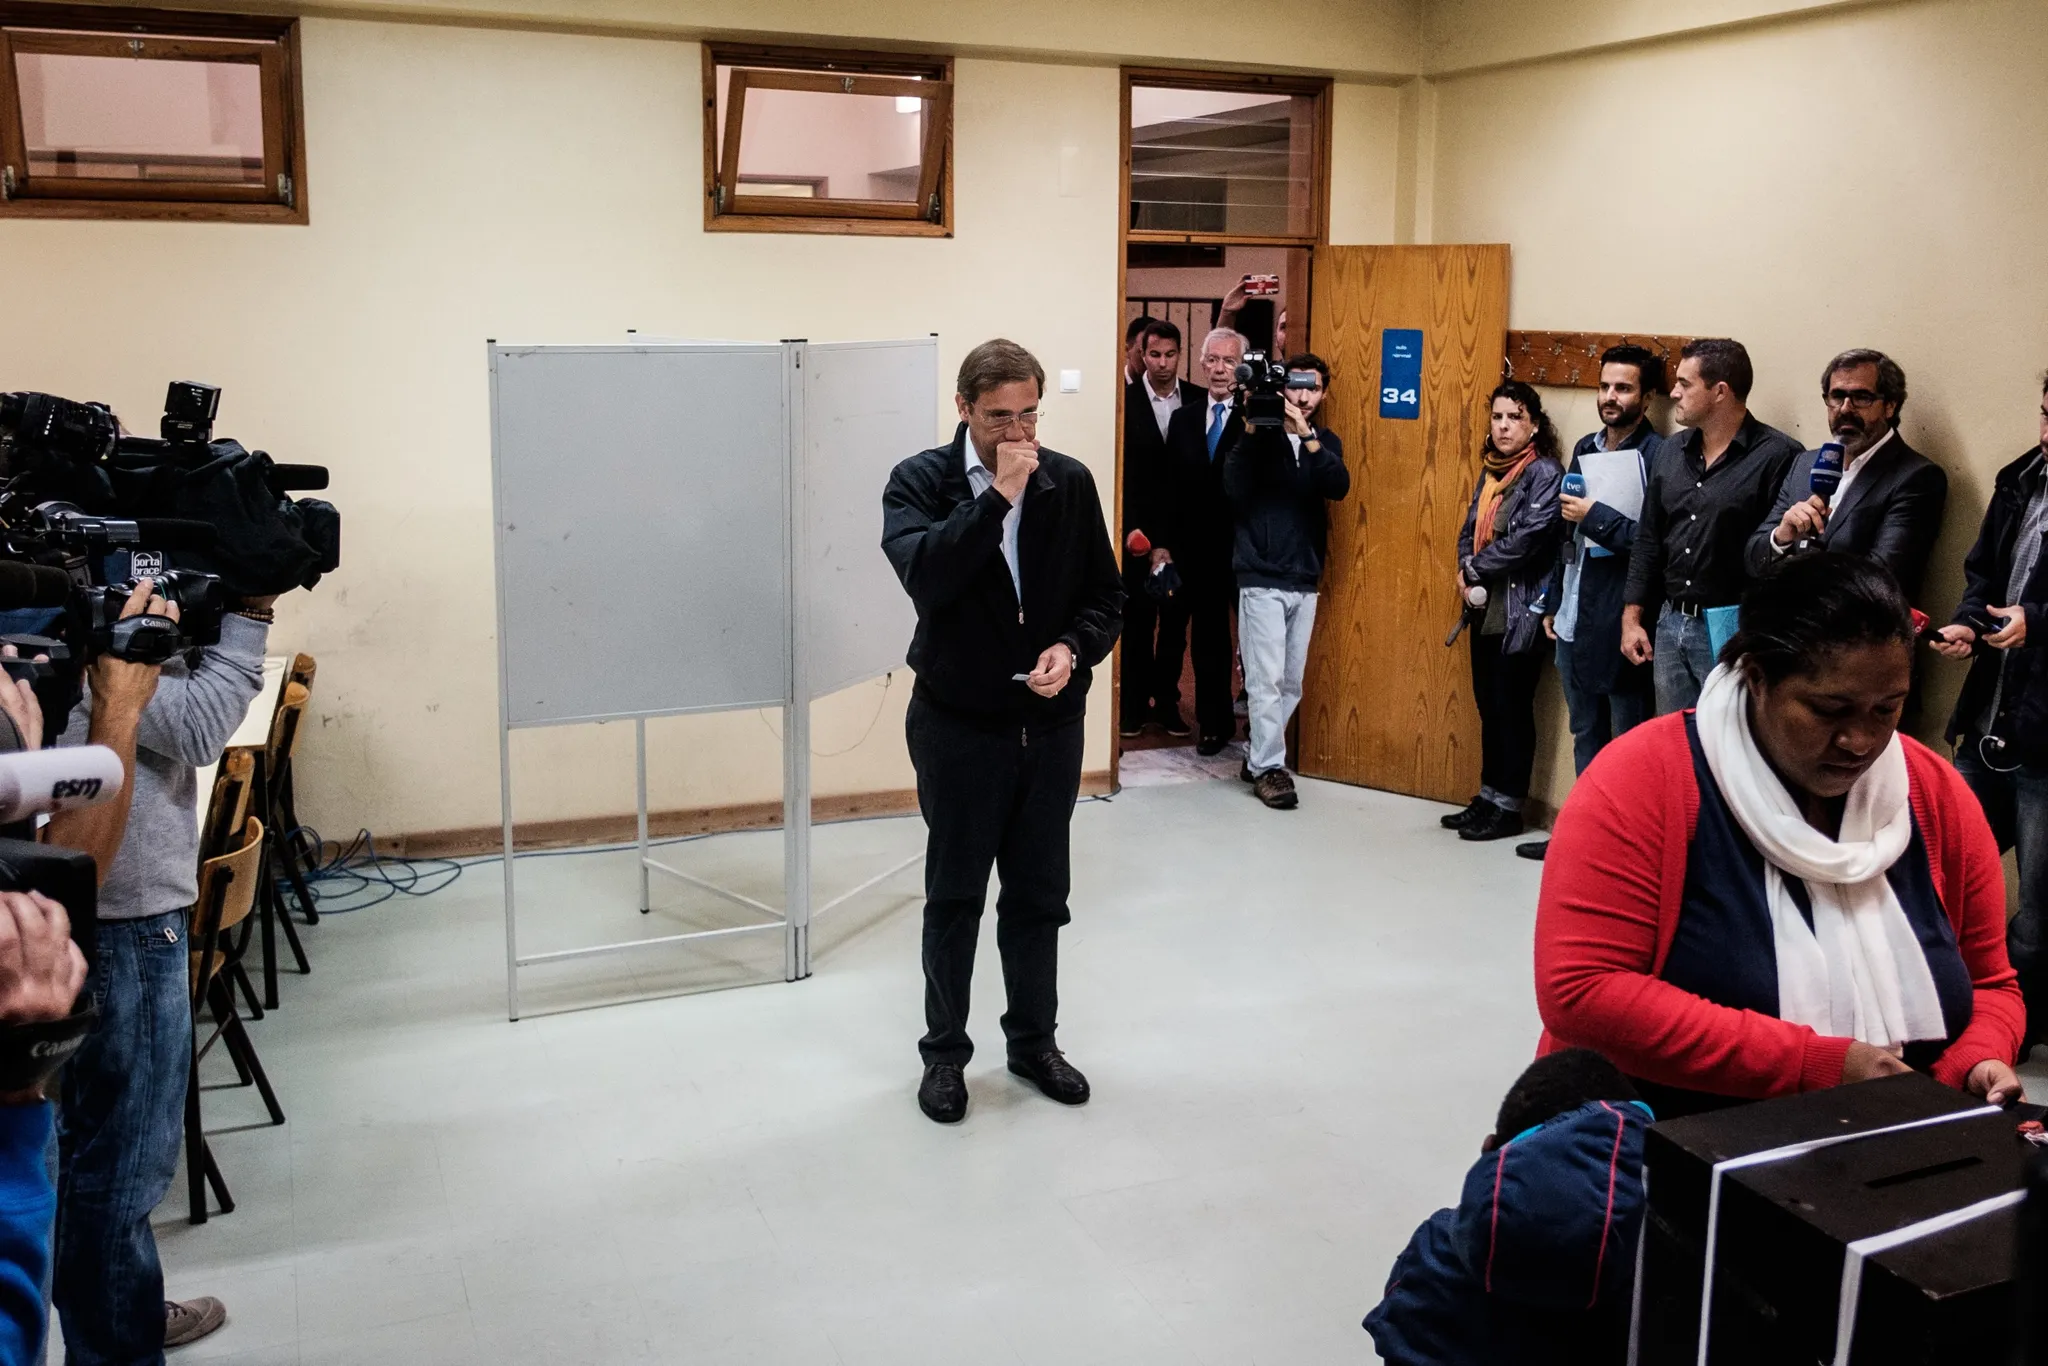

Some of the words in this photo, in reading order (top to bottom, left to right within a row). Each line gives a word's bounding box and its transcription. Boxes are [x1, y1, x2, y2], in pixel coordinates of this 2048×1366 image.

[1383, 388, 1417, 404] 34
[1566, 481, 1581, 492] tve
[134, 557, 160, 567] porta
[134, 567, 160, 575] brace
[141, 619, 171, 629] Canon
